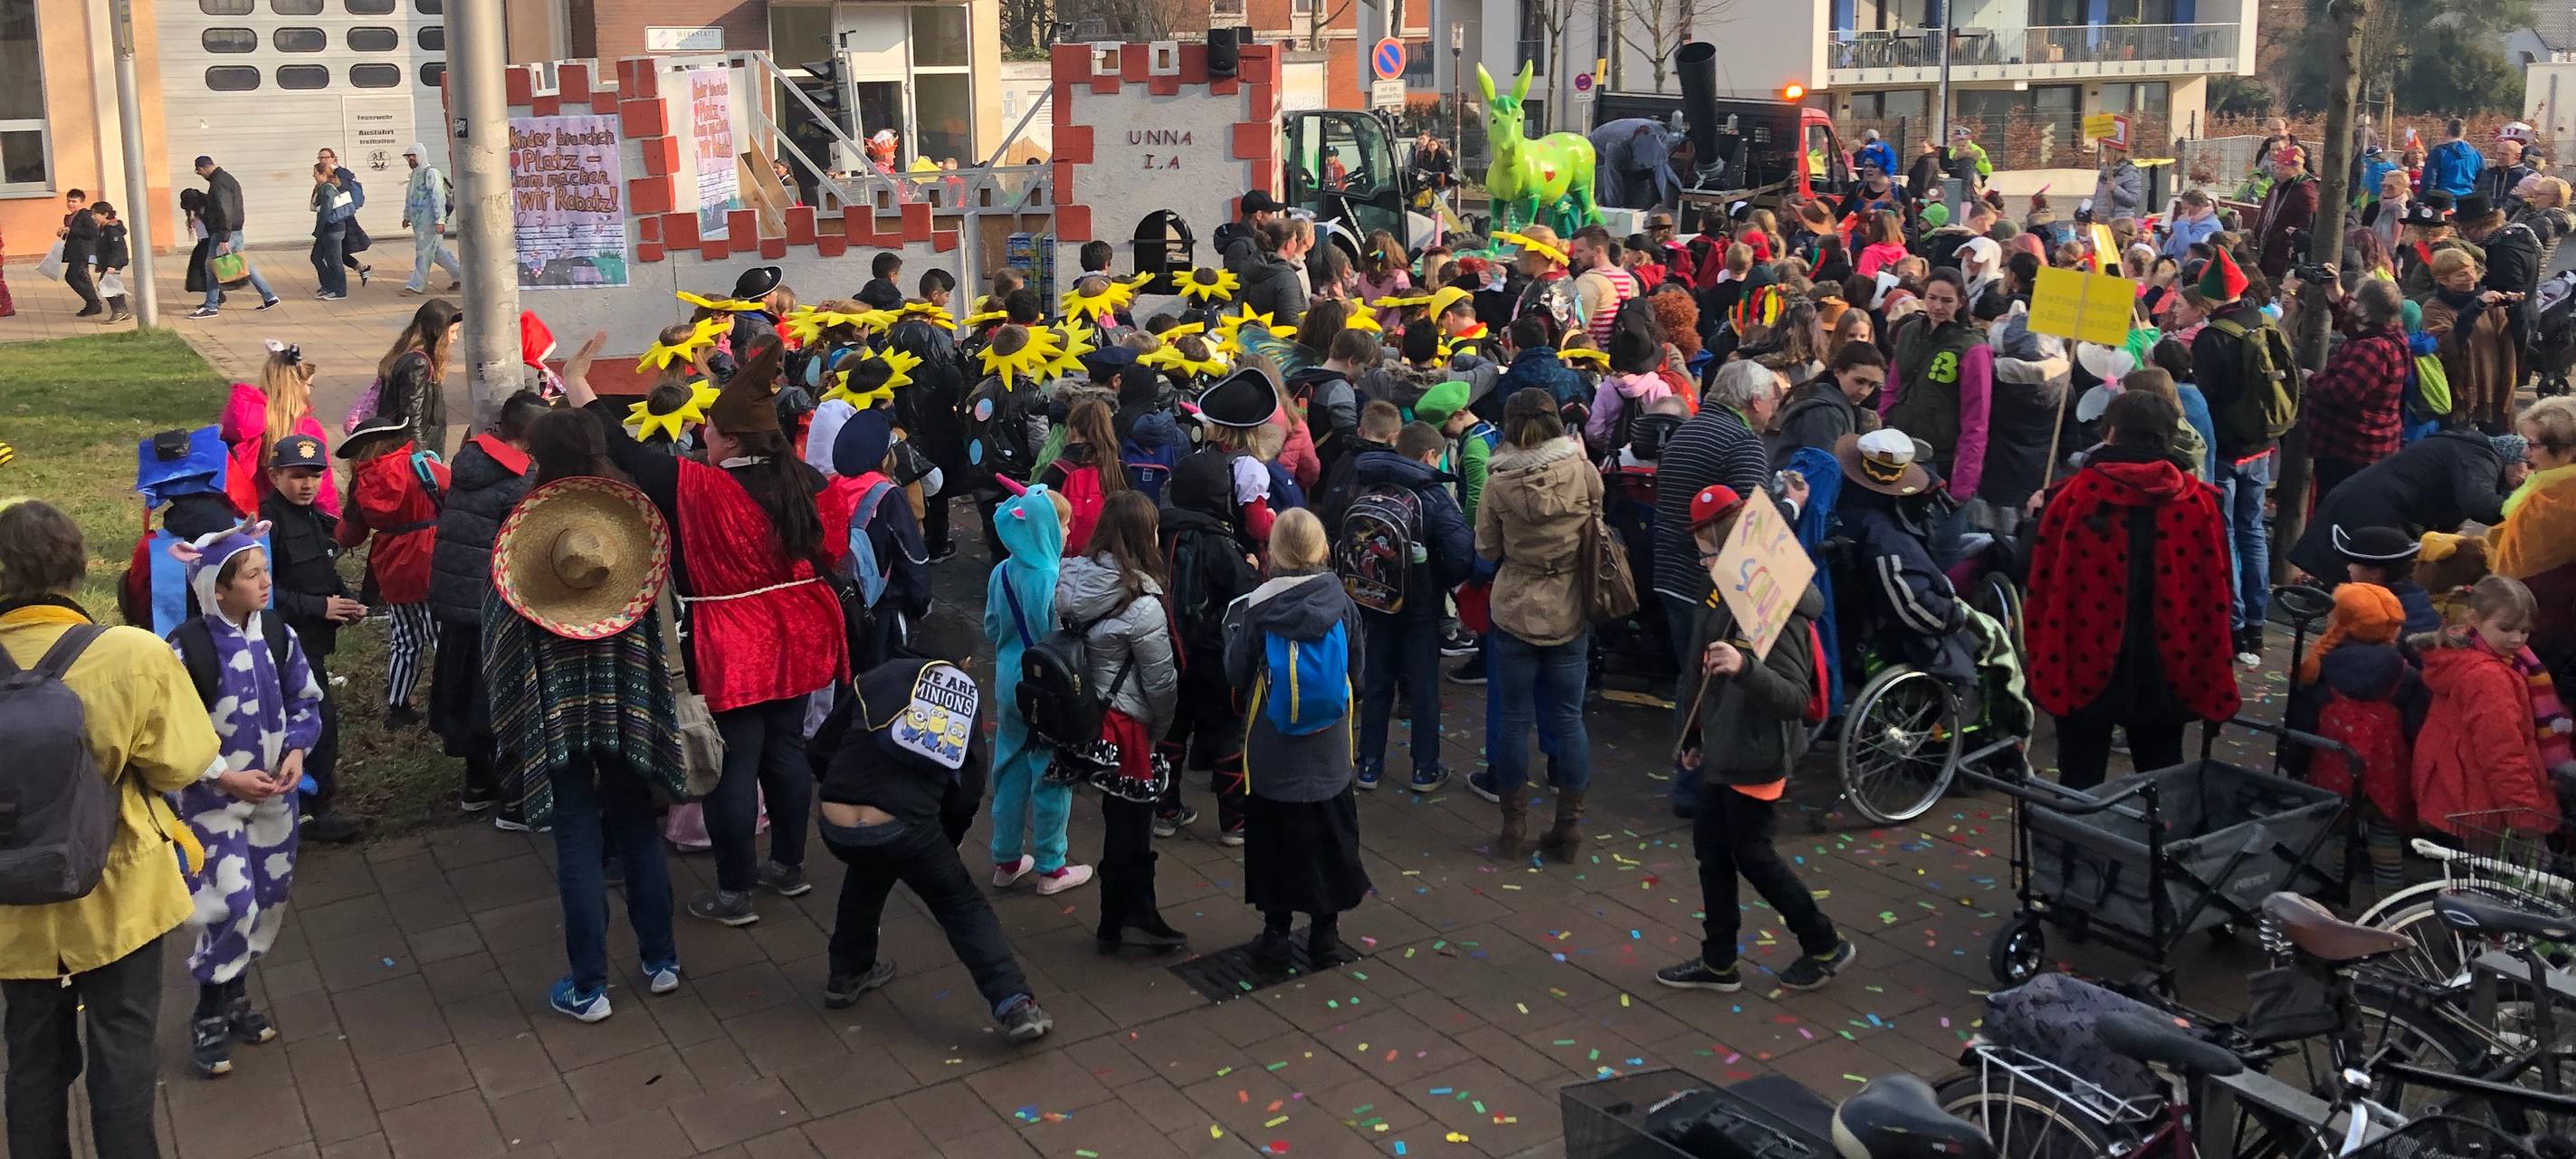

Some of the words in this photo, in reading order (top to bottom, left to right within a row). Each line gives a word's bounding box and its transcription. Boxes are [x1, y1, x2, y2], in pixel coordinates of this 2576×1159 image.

[509, 126, 551, 151] Kinder
[1130, 129, 1192, 146] UNNA
[522, 147, 580, 172] Platz
[548, 167, 611, 187] machen
[518, 187, 551, 211] wir
[555, 186, 618, 213] Rabatz!
[915, 681, 973, 716] MINIONS
[946, 675, 977, 698] ARE
